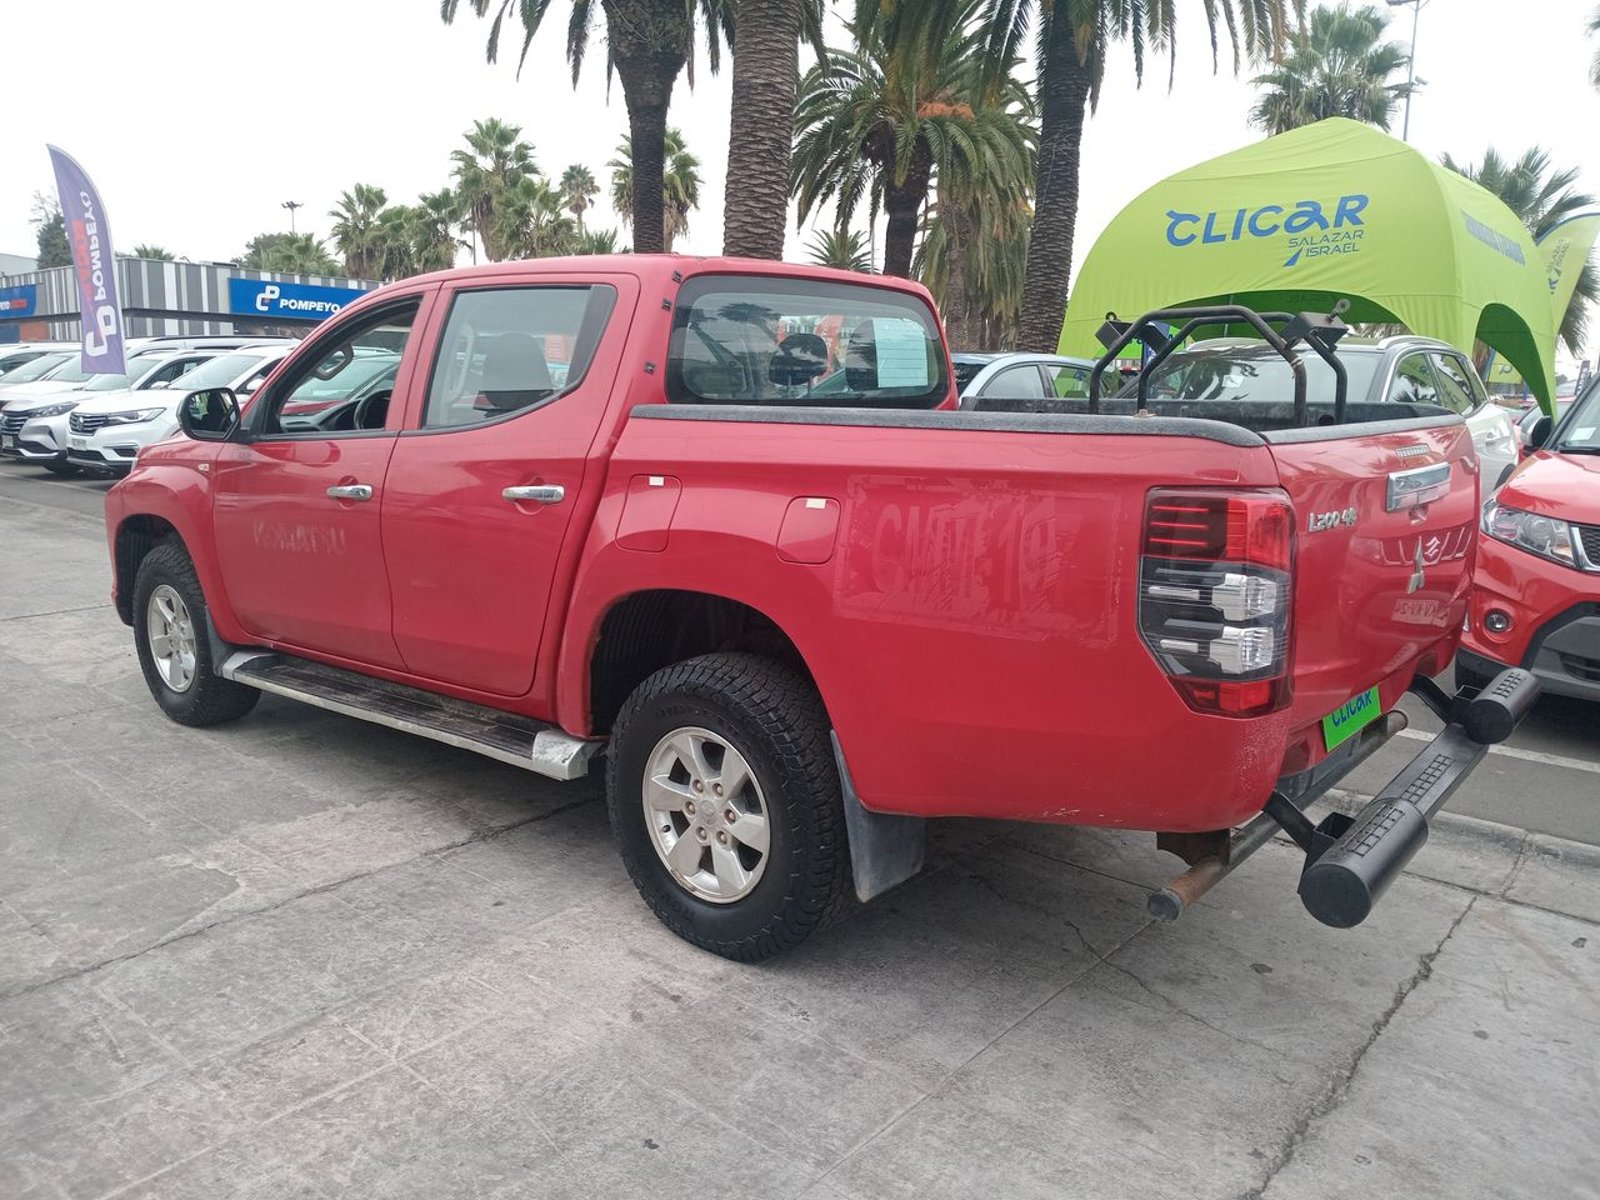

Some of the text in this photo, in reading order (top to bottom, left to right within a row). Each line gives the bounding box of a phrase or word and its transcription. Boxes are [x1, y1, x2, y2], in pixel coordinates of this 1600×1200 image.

[1288, 229, 1364, 248] SALAZAR
[1305, 244, 1360, 258] ISRAEL
[279, 298, 341, 314] POMPEYO
[1308, 510, 1340, 533] L200
